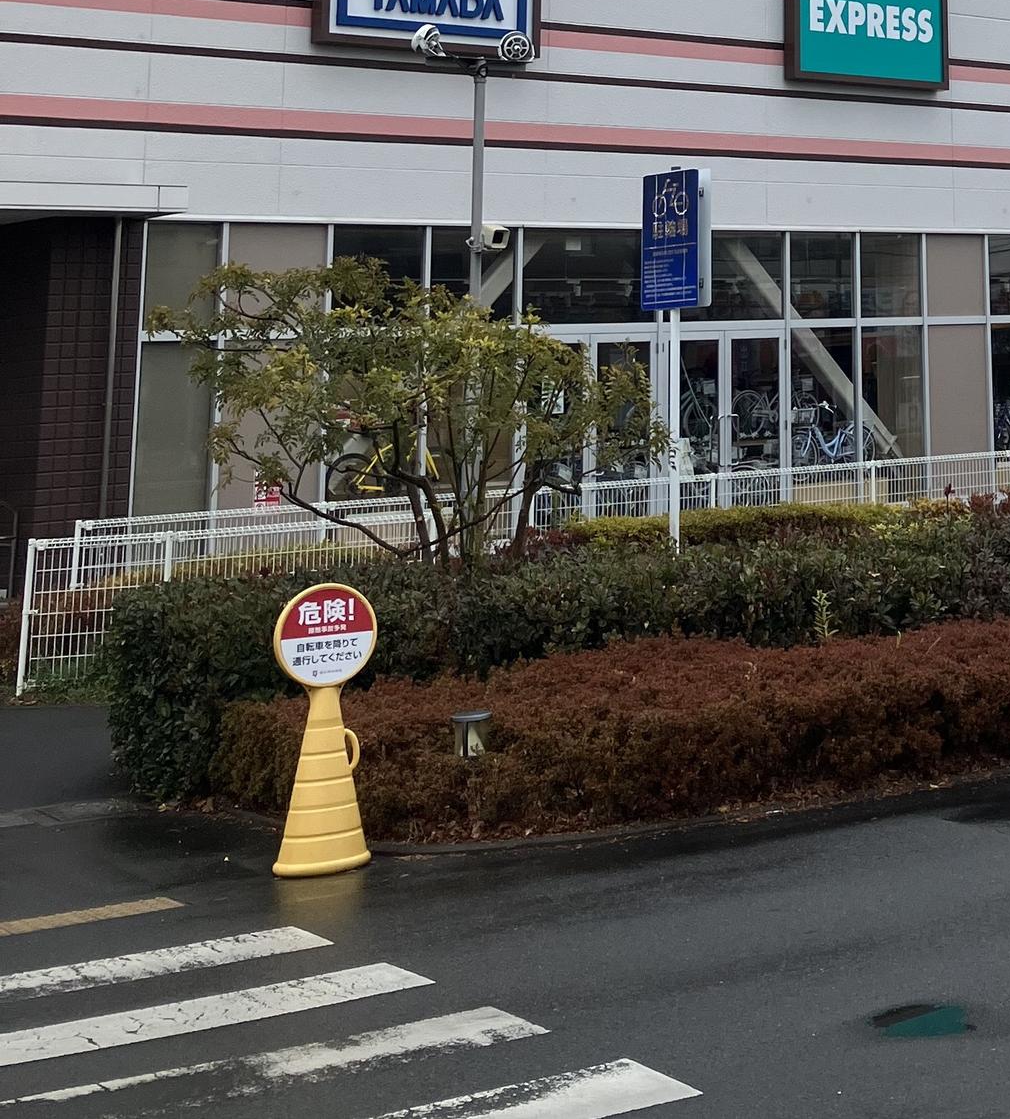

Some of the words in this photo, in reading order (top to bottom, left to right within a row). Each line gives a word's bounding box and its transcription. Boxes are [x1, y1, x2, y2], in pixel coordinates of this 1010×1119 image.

[296, 637, 358, 653] 自転車を降りて
[292, 650, 362, 667] 通行してください
